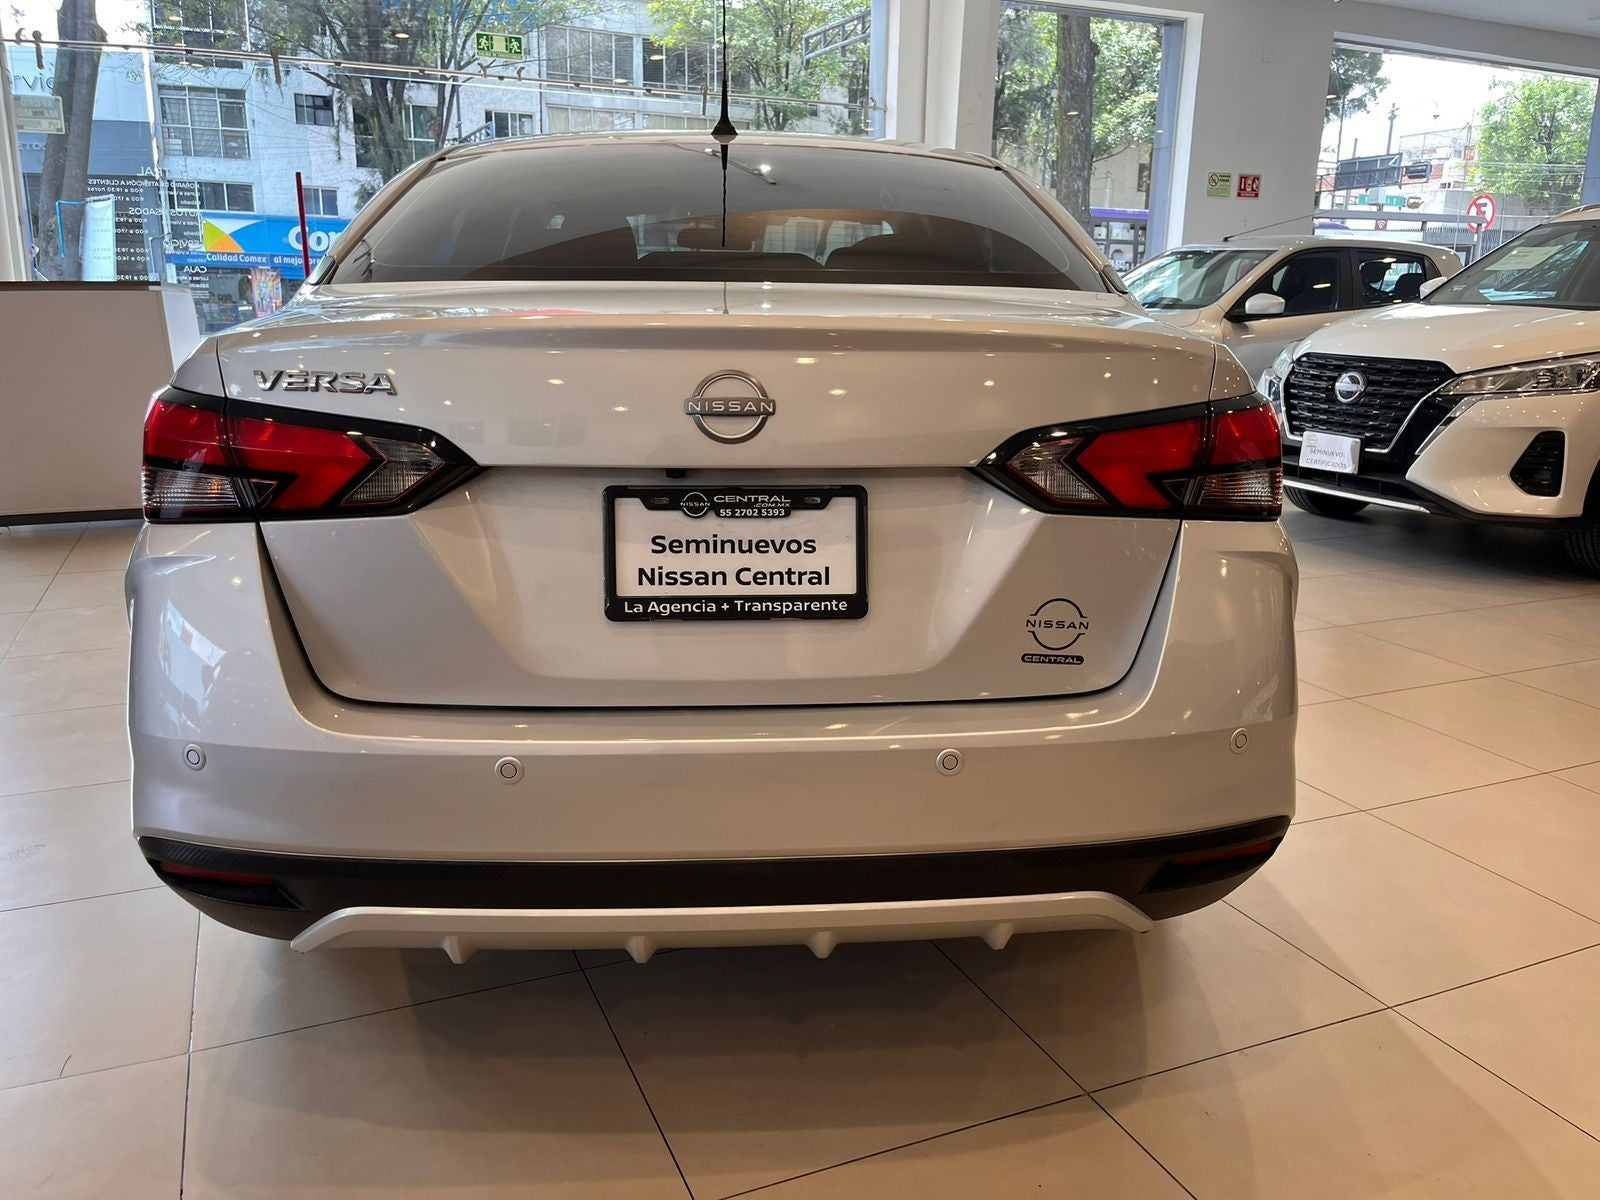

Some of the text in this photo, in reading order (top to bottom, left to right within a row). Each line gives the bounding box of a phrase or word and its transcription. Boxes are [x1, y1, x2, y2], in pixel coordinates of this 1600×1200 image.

[206, 253, 238, 262] Calidad
[239, 254, 267, 263] Comex
[273, 255, 282, 264] al
[253, 369, 398, 396] VERSA
[688, 400, 774, 413] NISSAN
[713, 495, 792, 503] CENTRAL
[719, 508, 786, 517] 55 2702 5393
[651, 534, 817, 555] Seminuevos
[637, 566, 830, 586] Nissan Central
[624, 600, 849, 616] La Agencia + Transparente
[1025, 618, 1090, 630] NISSAN
[1024, 655, 1082, 664] CENTRAL
